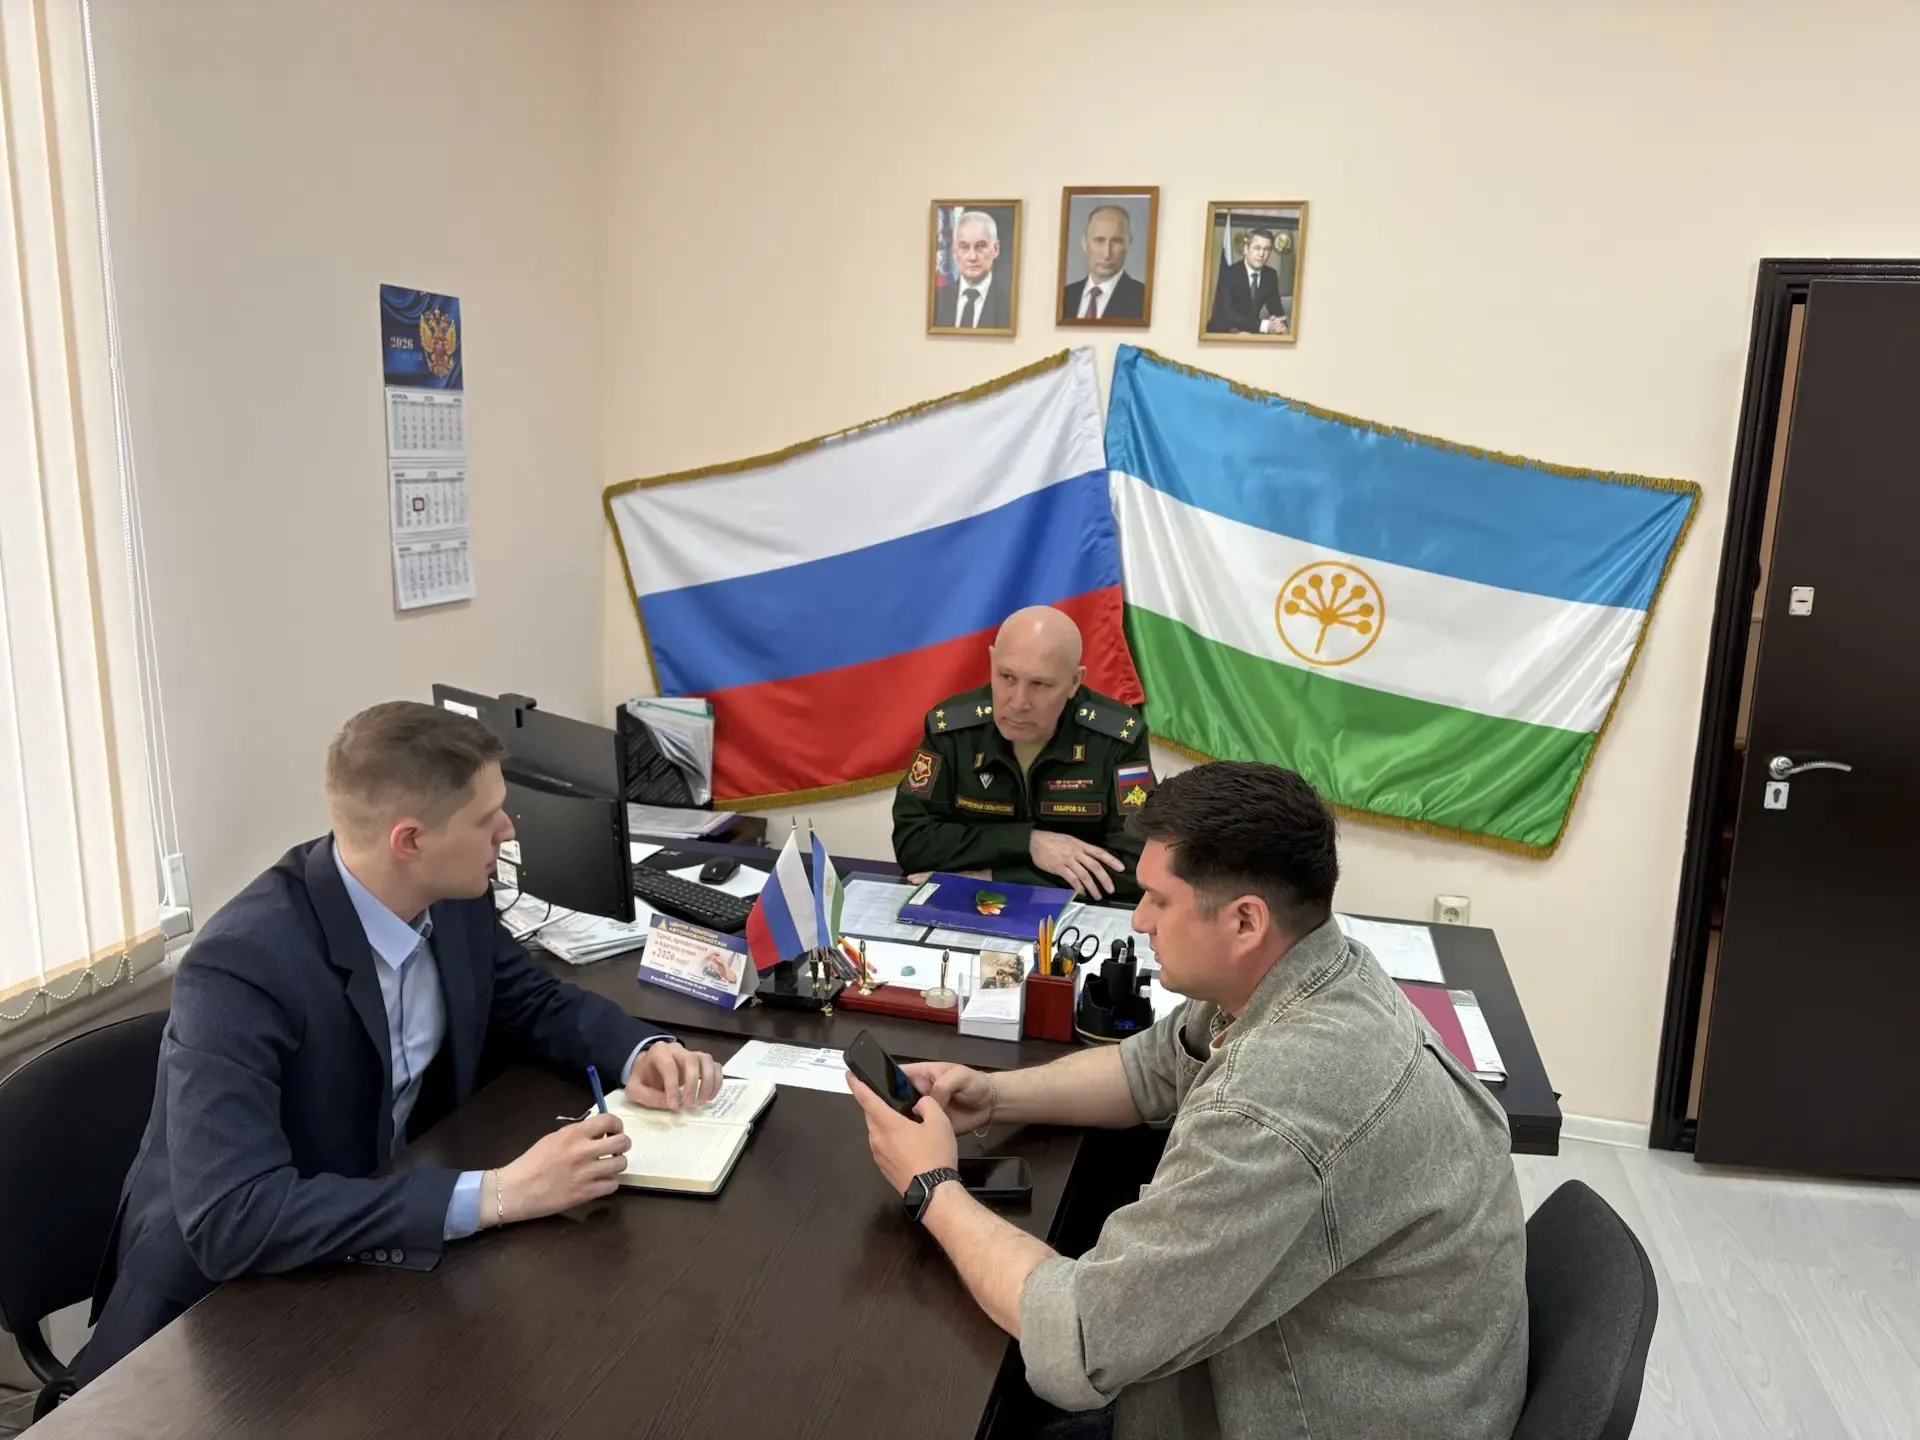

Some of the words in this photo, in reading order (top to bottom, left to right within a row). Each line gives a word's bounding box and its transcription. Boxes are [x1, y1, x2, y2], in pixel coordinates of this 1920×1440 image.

[390, 336, 414, 349] 2026
[996, 805, 1012, 813] РОССИИ
[1053, 805, 1077, 813] КАБИРОВ
[669, 921, 688, 930] ЦЕНТР
[690, 927, 719, 939] ПОМОЩИ
[668, 927, 728, 947] АВТОМОБИЛИСТАМ
[656, 948, 675, 961] 2026
